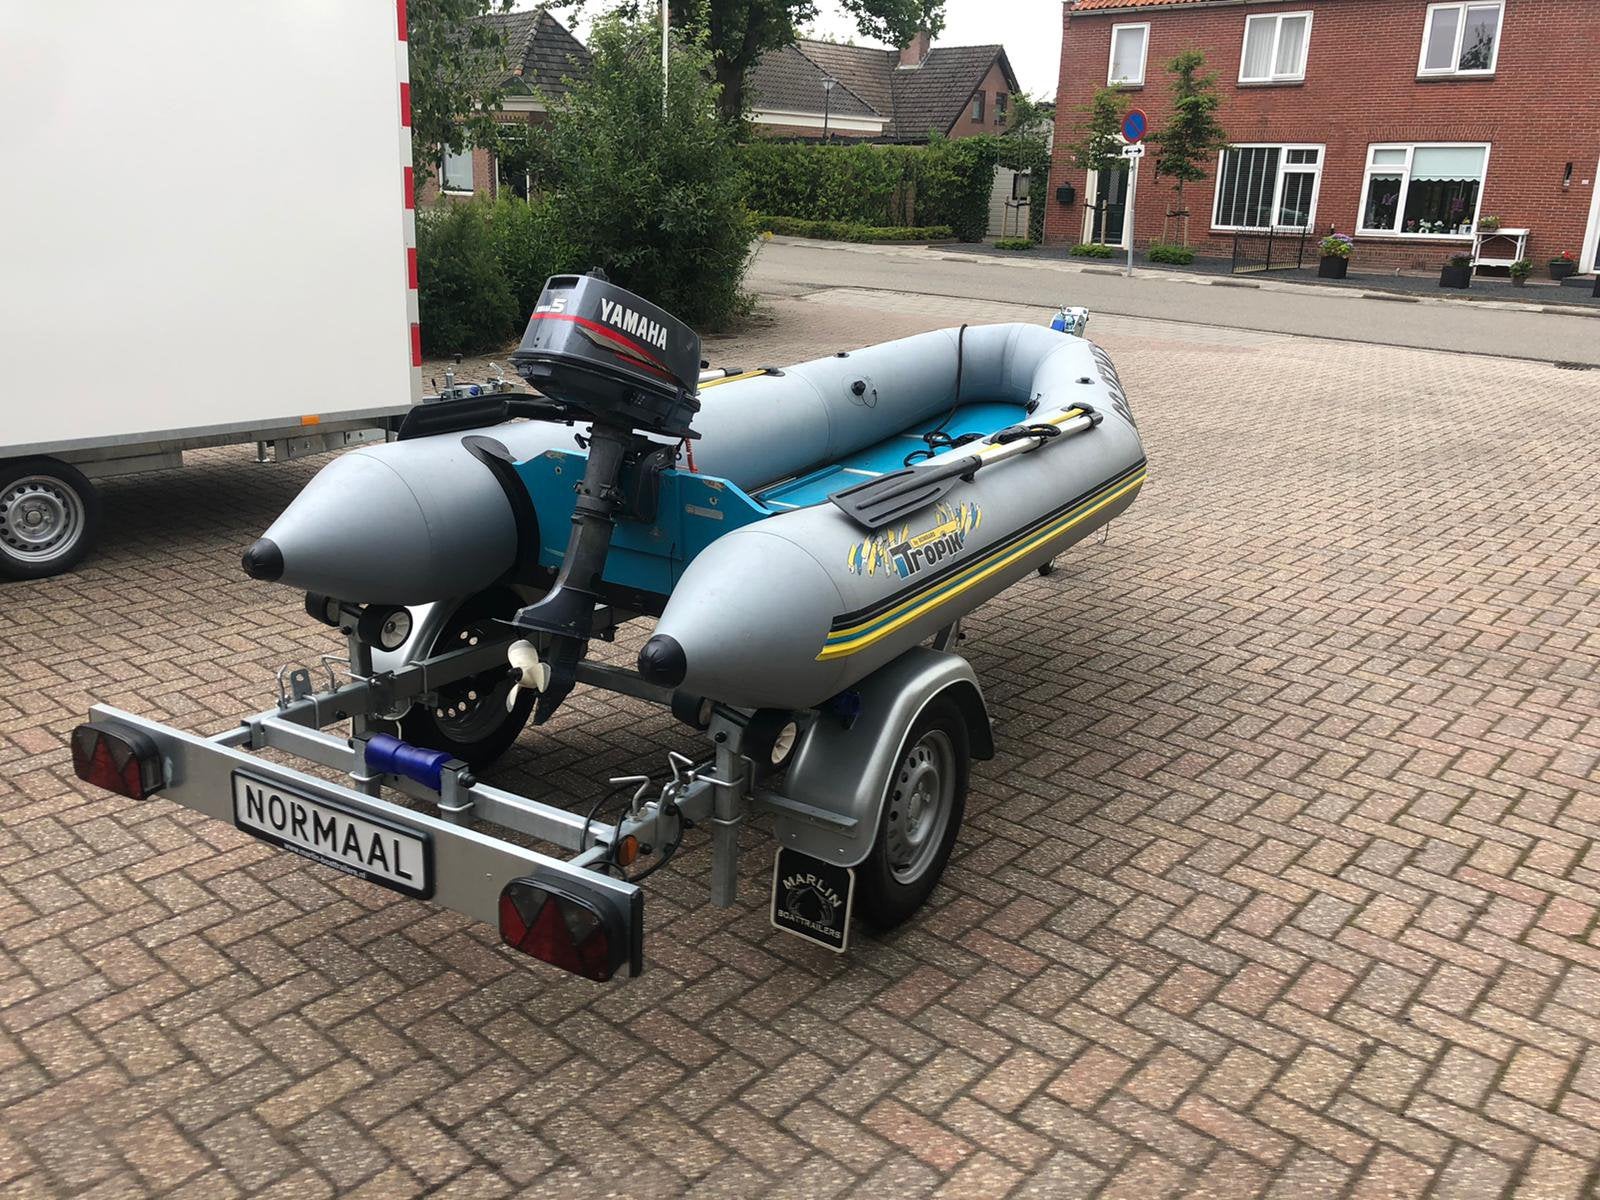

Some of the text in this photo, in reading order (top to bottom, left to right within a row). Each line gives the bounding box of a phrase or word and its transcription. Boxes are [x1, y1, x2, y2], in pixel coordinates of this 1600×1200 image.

[601, 298, 668, 350] YAMAHA
[246, 785, 412, 880] NORMAAL
[782, 874, 842, 907] MARLIN
[778, 909, 841, 939] BOATTRAILERS
